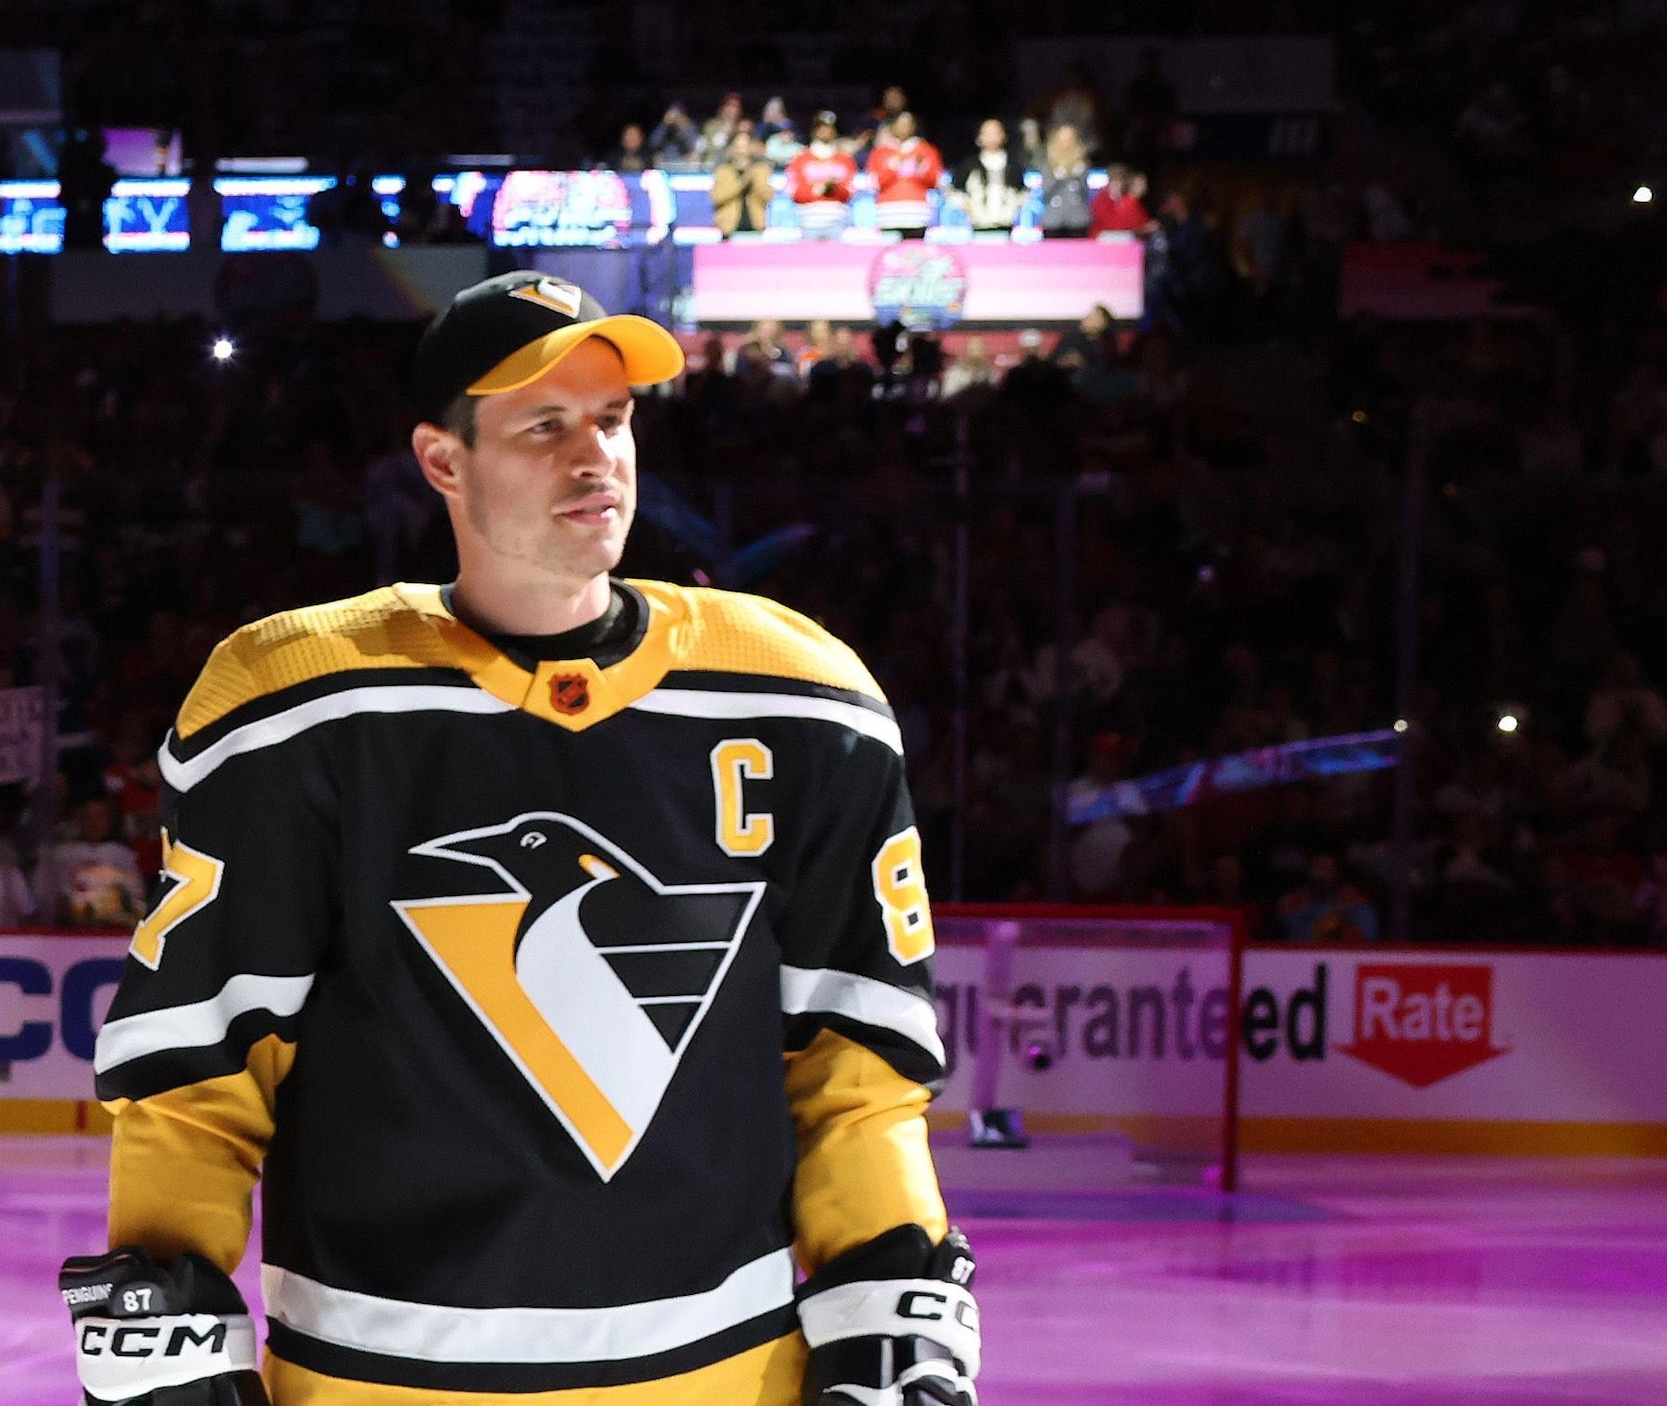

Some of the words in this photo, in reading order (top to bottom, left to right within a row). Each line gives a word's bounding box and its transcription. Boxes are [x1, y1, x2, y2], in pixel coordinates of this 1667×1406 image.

[709, 737, 775, 859] C
[129, 826, 226, 972] 7
[1366, 976, 1484, 1042] Rate
[122, 1287, 153, 1312] 87
[81, 1322, 227, 1358] CCM
